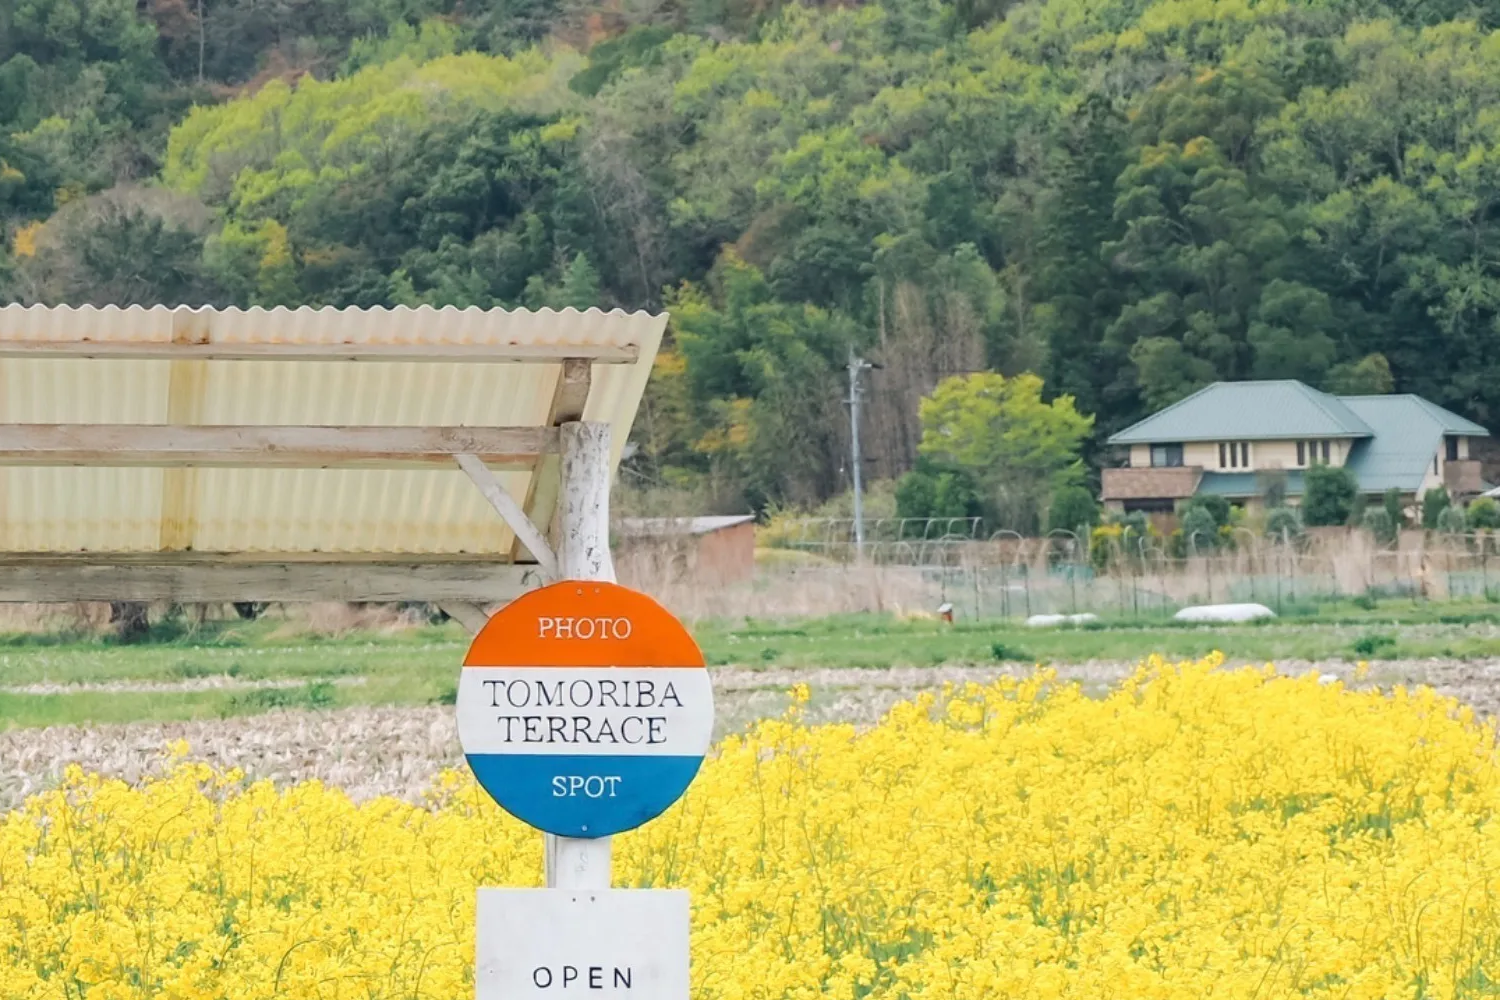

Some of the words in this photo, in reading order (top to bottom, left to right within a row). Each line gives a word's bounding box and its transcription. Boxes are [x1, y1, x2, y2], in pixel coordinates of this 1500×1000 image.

[538, 616, 632, 640] PHOTO
[482, 679, 684, 708] TOMORIBA
[497, 715, 667, 745] TERRACE
[551, 775, 623, 798] SPOT
[532, 965, 632, 990] OPEN
